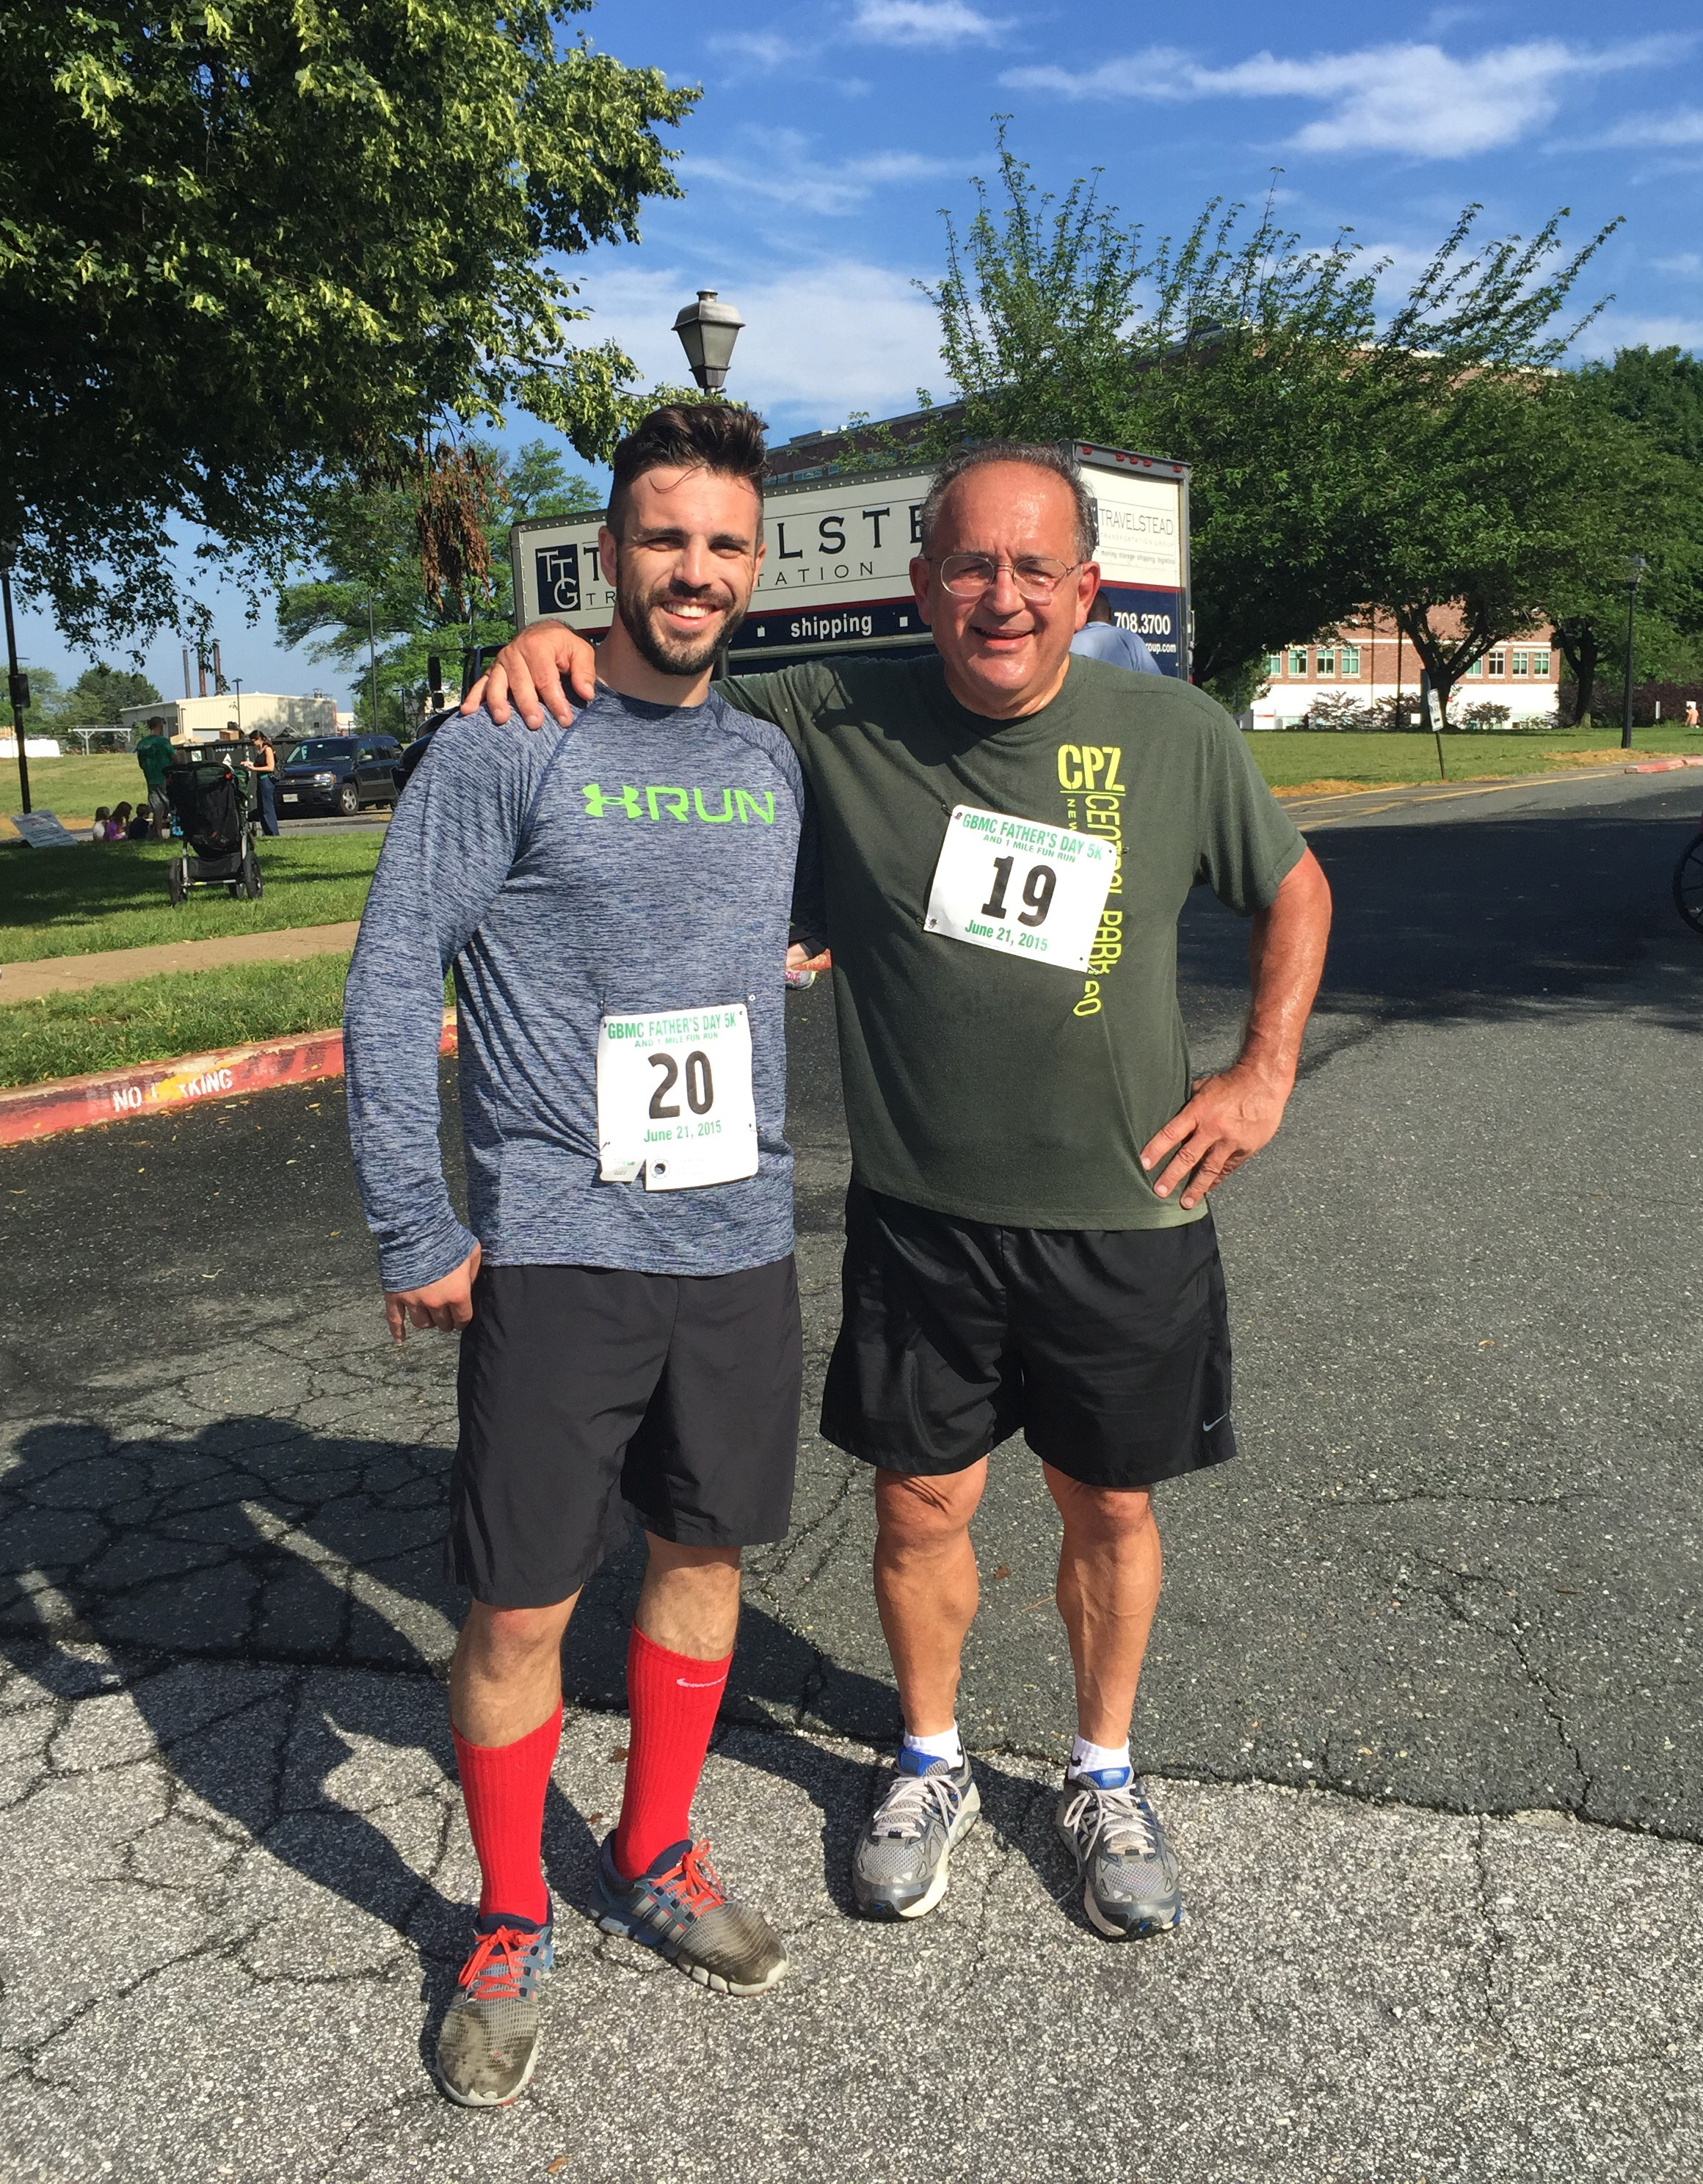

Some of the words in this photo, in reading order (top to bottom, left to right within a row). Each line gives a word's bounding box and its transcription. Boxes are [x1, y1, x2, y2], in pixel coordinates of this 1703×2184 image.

[1099, 508, 1174, 536] TRAVELSTEAD
[791, 613, 873, 640] shipping
[1058, 744, 1125, 791] CPZ
[645, 786, 775, 824] RUN
[962, 813, 998, 834] GBMC
[1000, 821, 1058, 848] FATHER'S
[1060, 836, 1085, 855] DAY
[1086, 843, 1103, 861] 5K
[983, 834, 1003, 845] AND
[1012, 841, 1034, 853] MILE
[1036, 847, 1055, 858] FUN
[1057, 852, 1075, 863] RUN
[981, 856, 1057, 927] 19
[965, 920, 994, 938] June
[996, 927, 1014, 947] 21,
[1018, 932, 1048, 951] 2015
[608, 1022, 644, 1040] GBMC
[649, 1016, 700, 1036] FATHER'S
[702, 1013, 722, 1030] DAY
[724, 1012, 736, 1028] 5K
[634, 1039, 654, 1048] AND
[665, 1036, 683, 1044] MILE
[686, 1033, 700, 1042] FUN
[112, 1086, 142, 1113] NO
[150, 1068, 233, 1099] KING
[647, 1050, 714, 1120] 20
[644, 1129, 672, 1143] June
[676, 1125, 694, 1140] 21,
[697, 1120, 722, 1137] 2015
